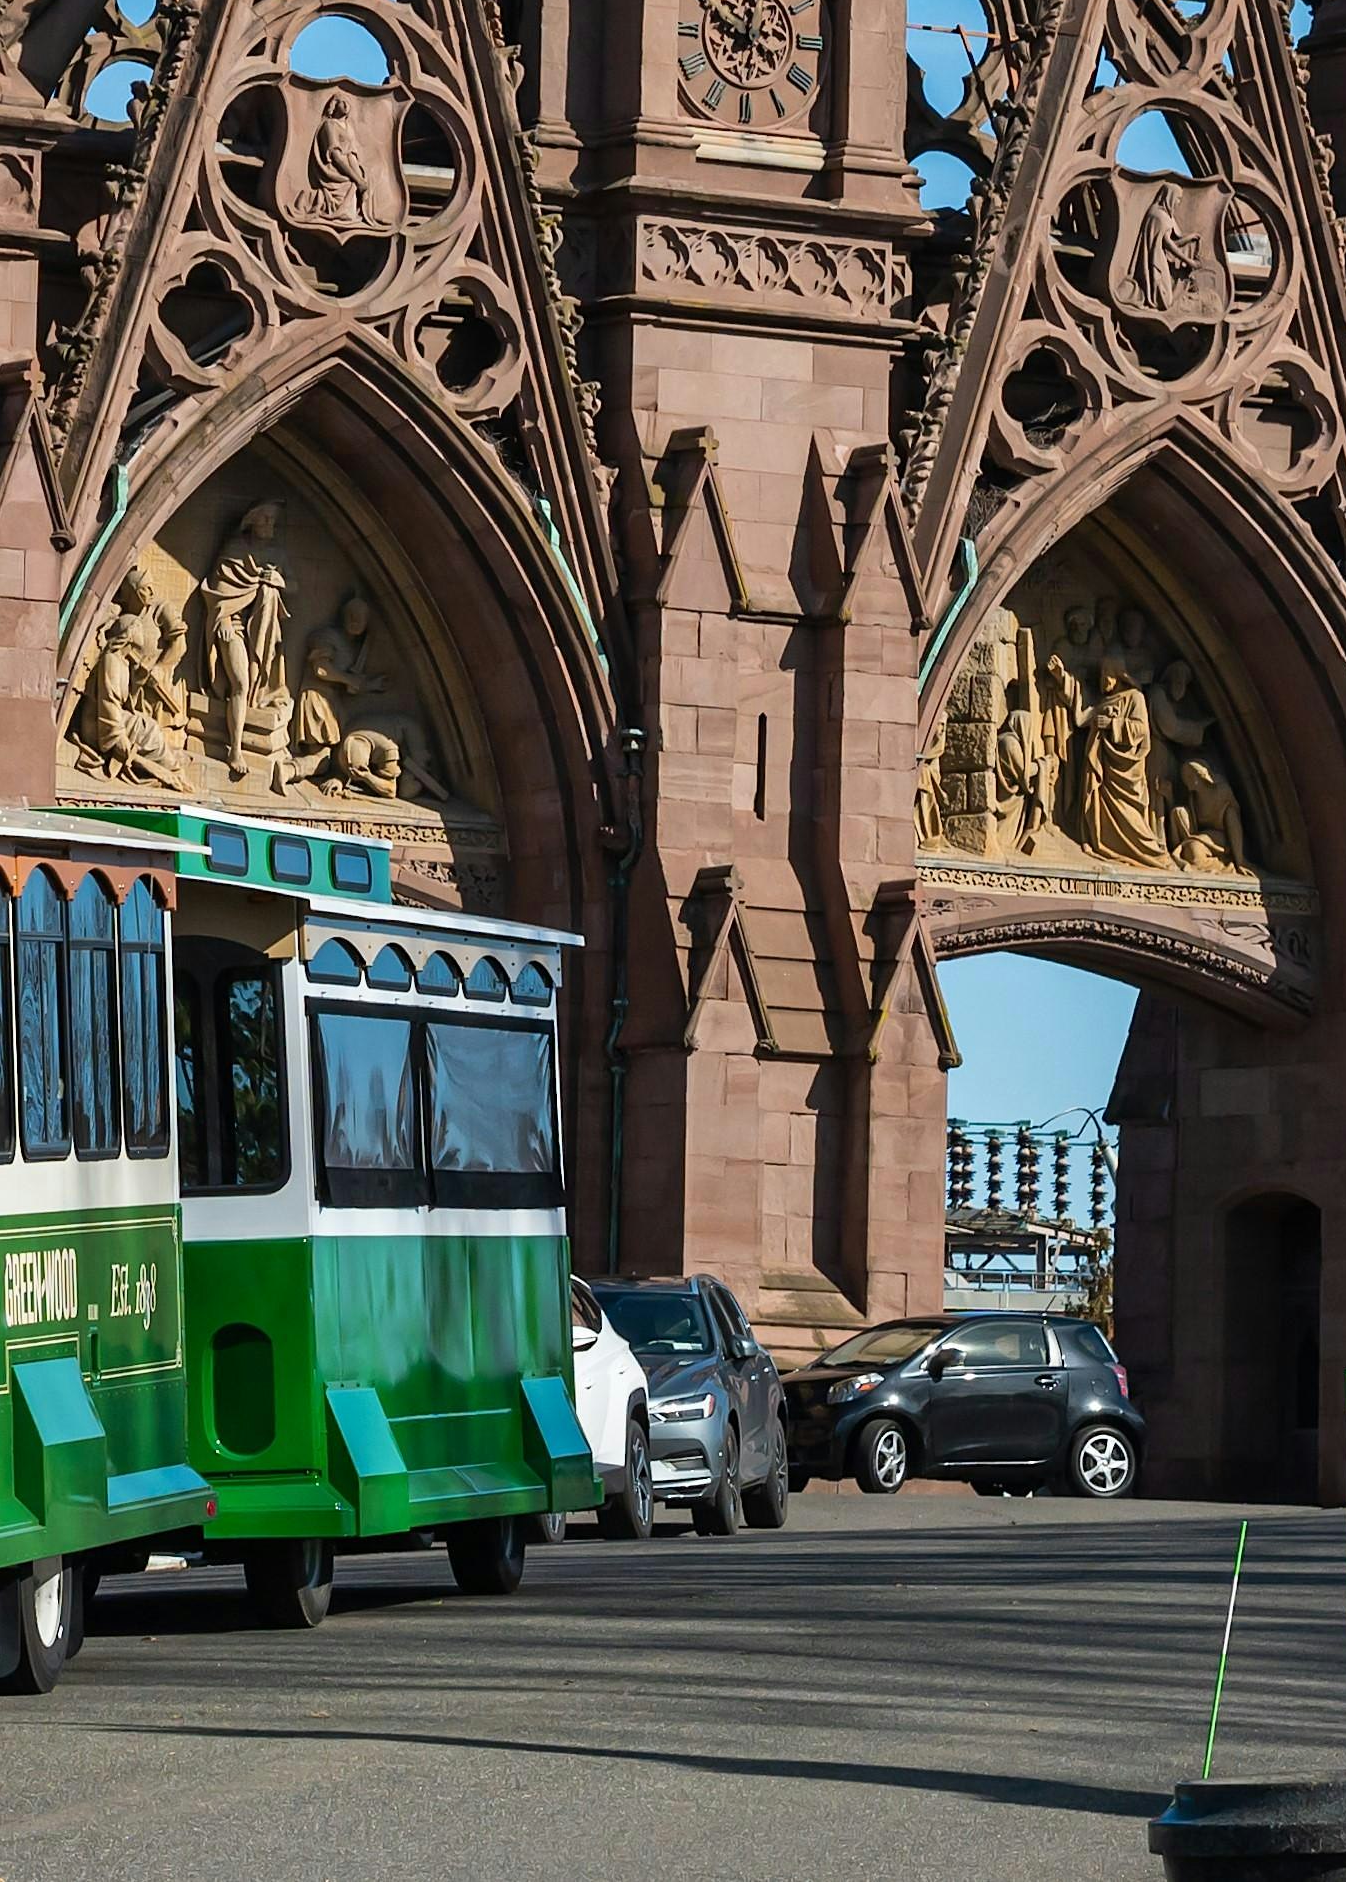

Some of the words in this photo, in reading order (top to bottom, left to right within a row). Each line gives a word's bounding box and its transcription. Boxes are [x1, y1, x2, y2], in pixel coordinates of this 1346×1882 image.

[5, 1248, 78, 1327] GREEN-WOOD
[110, 1263, 132, 1317] Est.
[135, 1263, 157, 1330] 1838
